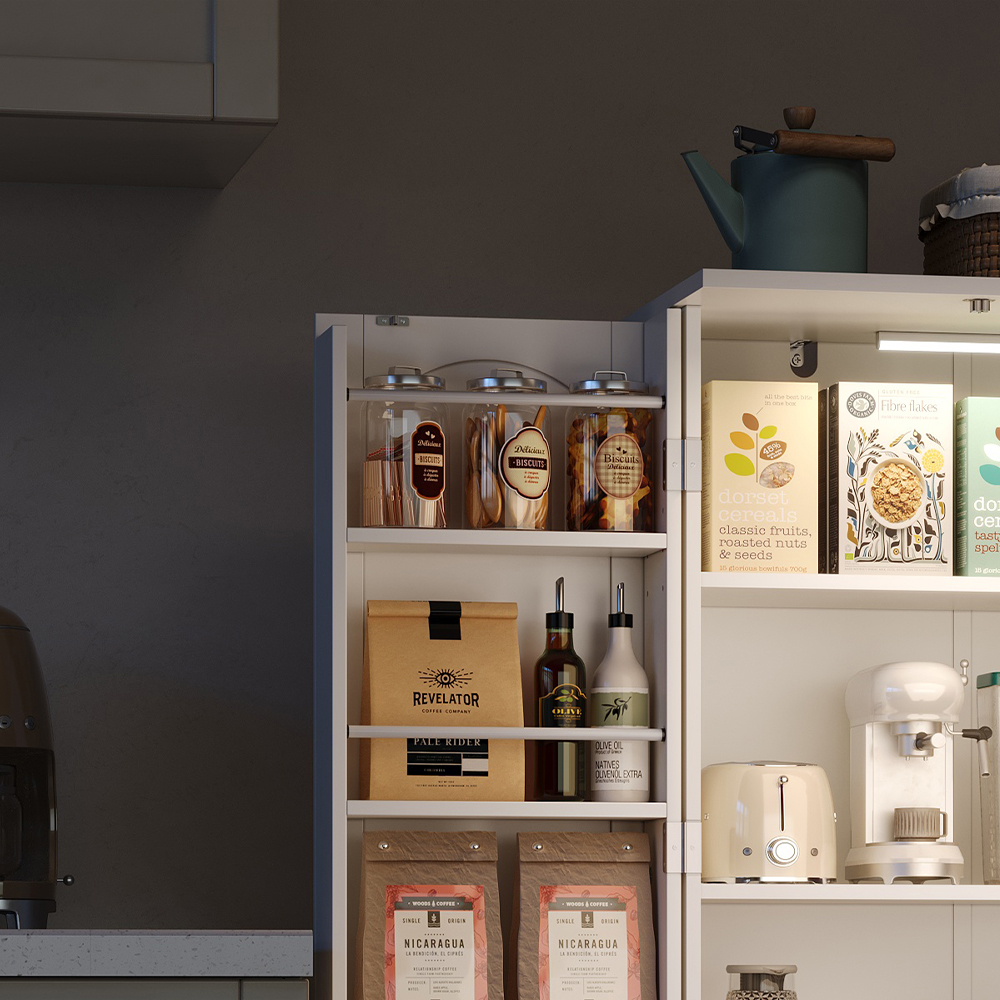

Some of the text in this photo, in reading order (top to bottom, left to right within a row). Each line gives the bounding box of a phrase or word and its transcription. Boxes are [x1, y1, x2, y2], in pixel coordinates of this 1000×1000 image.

[881, 399, 938, 413] Fibre flakes
[419, 455, 441, 464] BISCUITS
[515, 458, 545, 468] BISCUITS
[604, 453, 640, 464] Biscuits
[719, 488, 789, 505] dorset
[719, 507, 798, 523] cereals
[719, 525, 812, 538] classic fruits,
[719, 538, 808, 549] roasted nuts
[719, 549, 773, 560] & seeds
[728, 565, 757, 573] glorious
[413, 692, 480, 708] REVELATOR
[552, 708, 583, 716] OLIVE
[413, 738, 481, 747] PALE RIDER
[595, 741, 624, 750] OLIVE OIL
[595, 760, 620, 770] NATIVES
[623, 769, 643, 779] EXTRA
[404, 938, 465, 949] NICARAGUA
[558, 939, 619, 949] NICARAGUA
